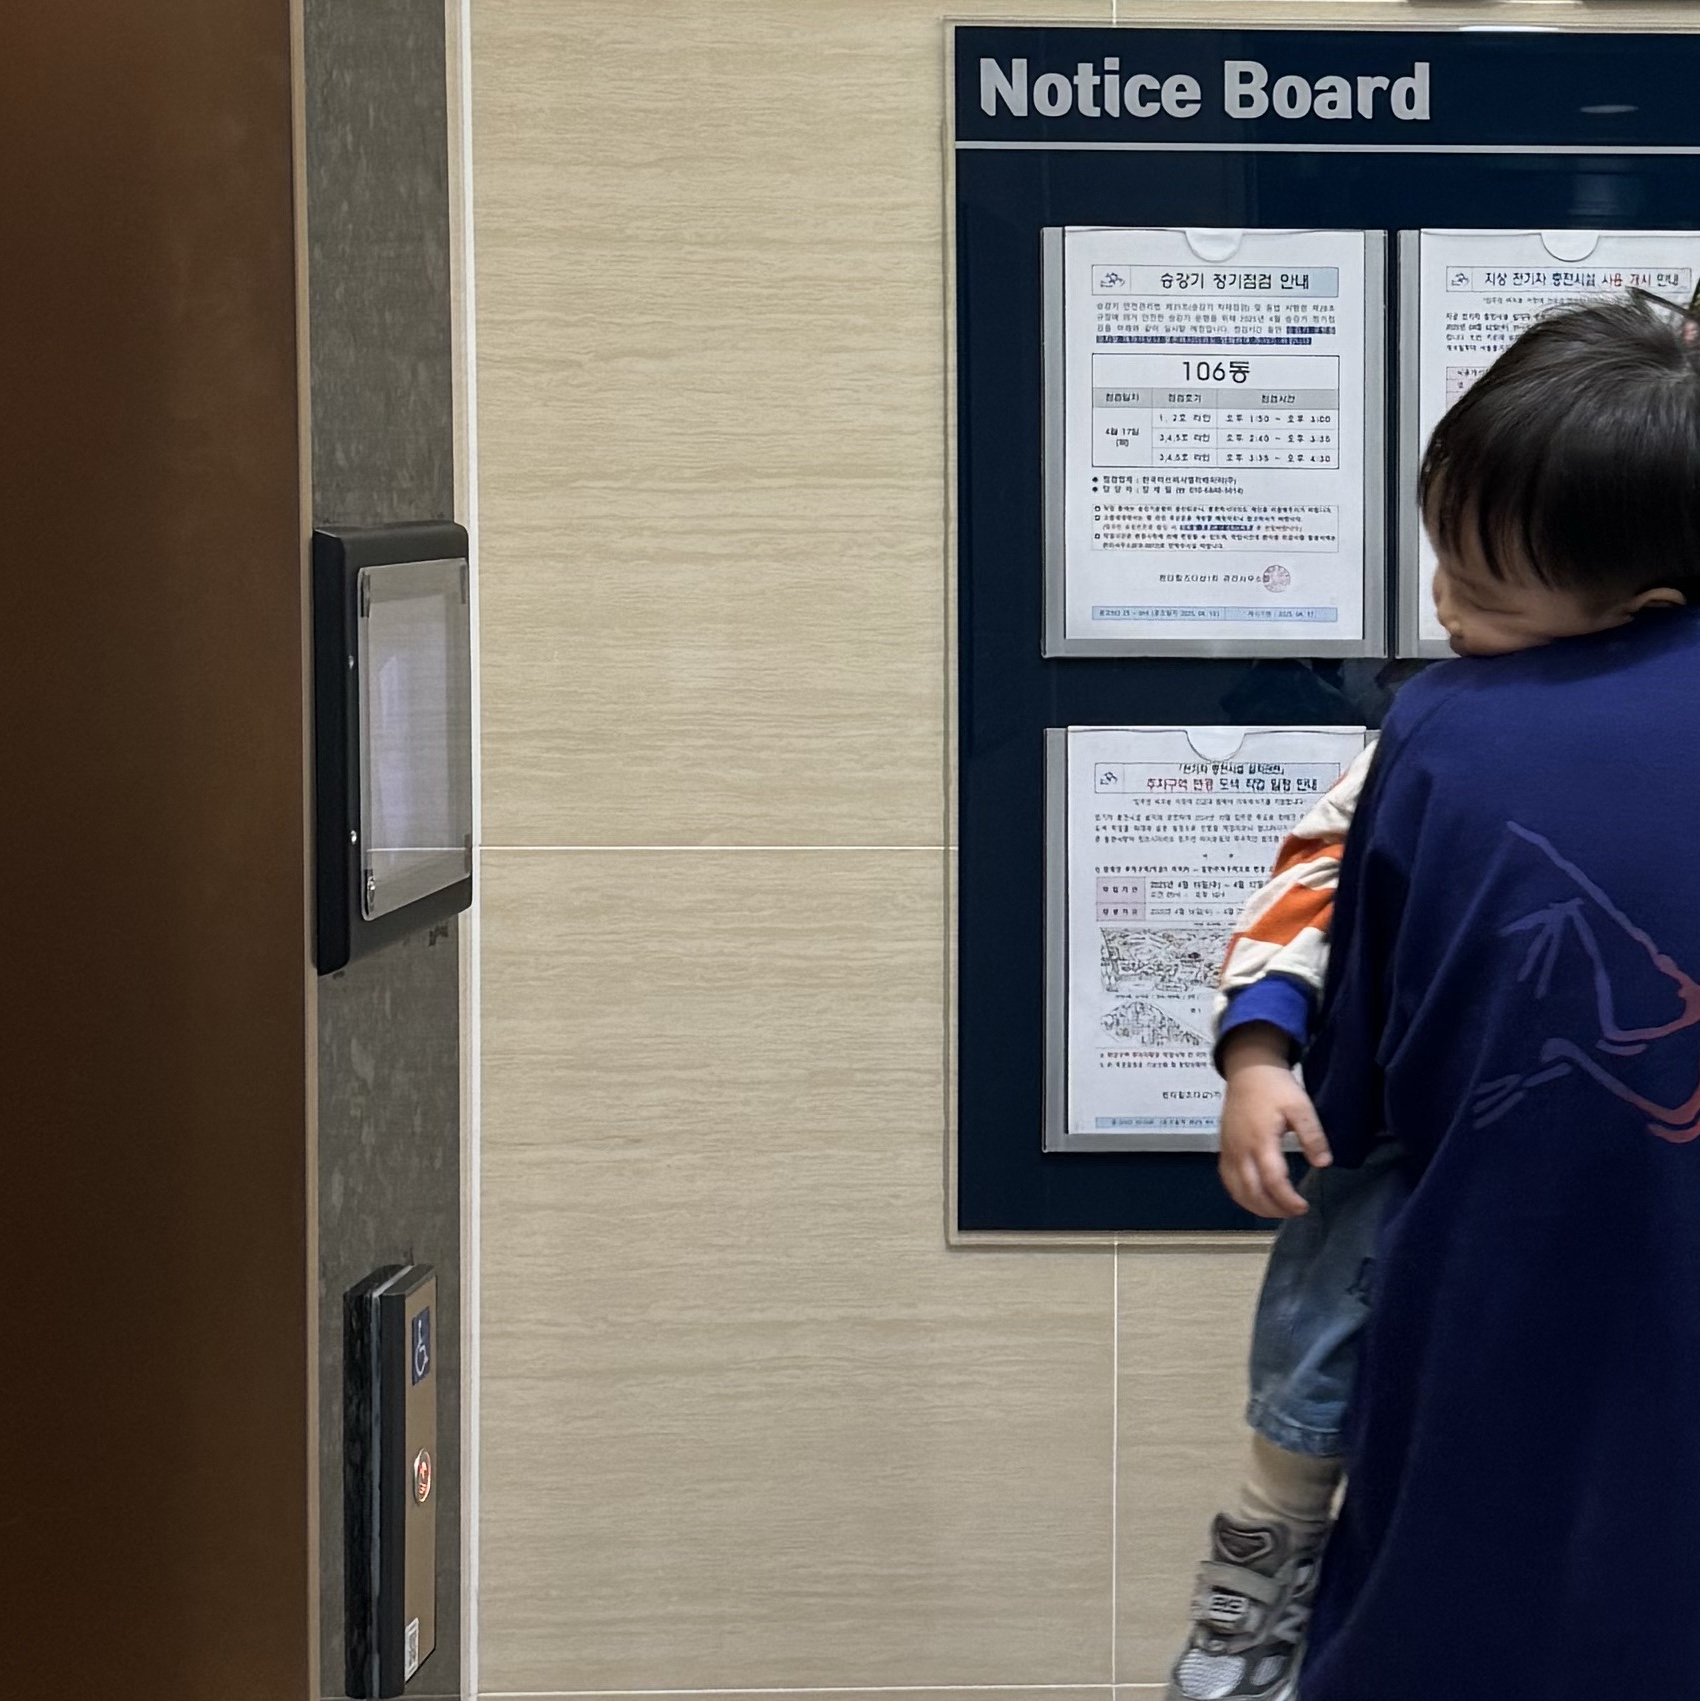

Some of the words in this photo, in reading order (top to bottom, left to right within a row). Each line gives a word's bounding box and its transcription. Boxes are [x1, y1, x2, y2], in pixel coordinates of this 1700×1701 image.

[980, 57, 1201, 118] Notice
[1224, 60, 1430, 120] Board
[1161, 272, 1204, 290] 승강기
[1213, 273, 1272, 290] 정기점검
[1280, 273, 1310, 290] 안내
[1485, 272, 1507, 287] 지상
[1512, 272, 1547, 287] 전기차
[1601, 272, 1623, 287] 사용
[1630, 273, 1651, 287] 개시
[1657, 273, 1679, 287] 안내
[1183, 361, 1250, 384] 106동
